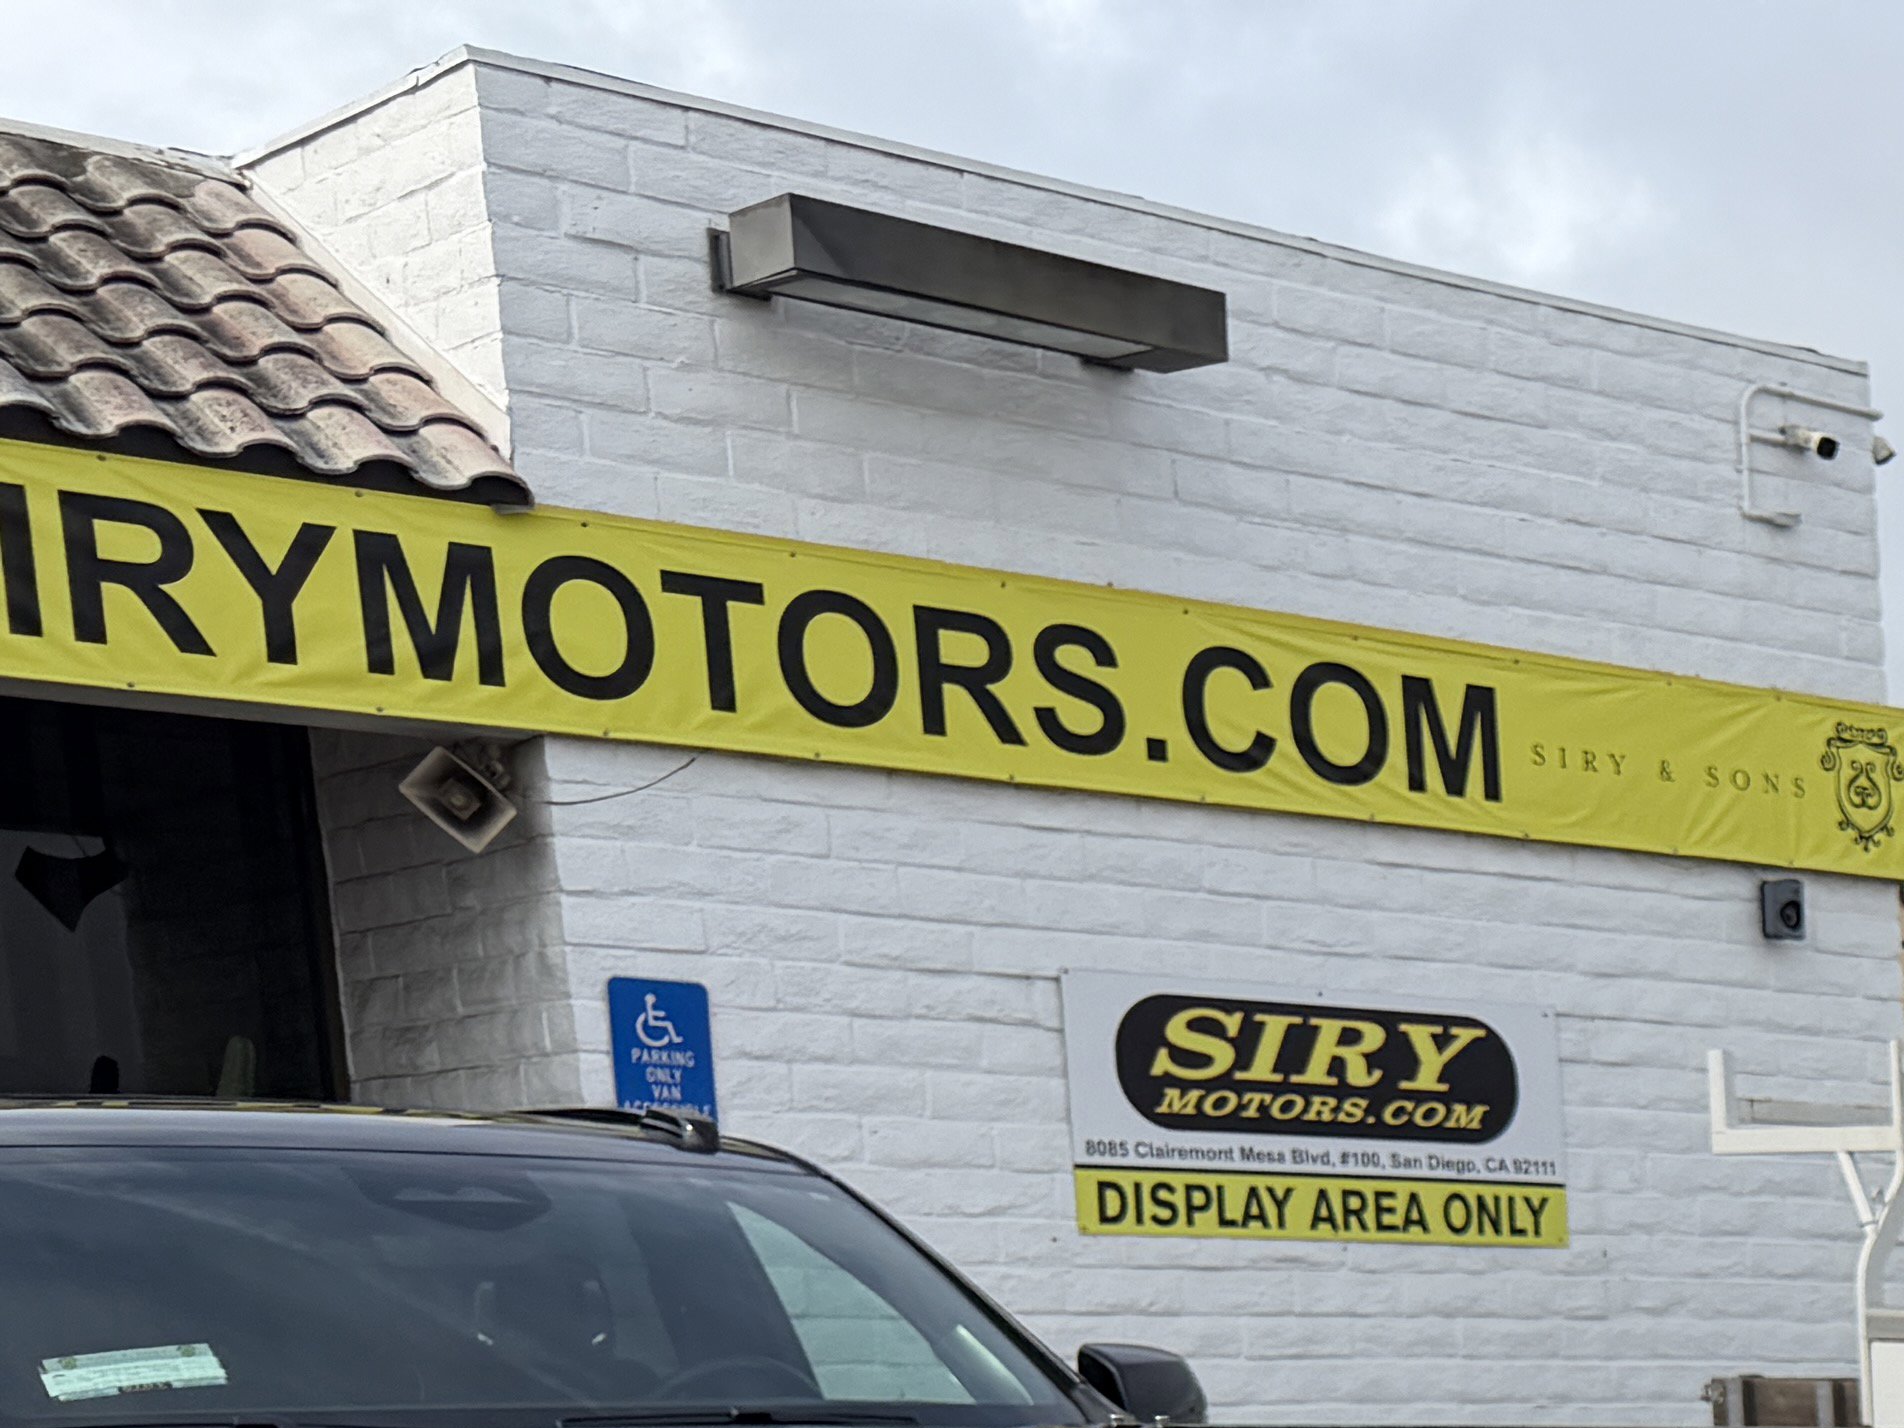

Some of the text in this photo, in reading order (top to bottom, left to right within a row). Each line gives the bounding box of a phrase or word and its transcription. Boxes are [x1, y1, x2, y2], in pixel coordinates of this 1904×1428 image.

[1529, 742, 1807, 799] SIRY & SONS
[631, 1047, 695, 1068] PARKING
[1149, 1007, 1487, 1093] SIRY
[645, 1066, 683, 1084] ONLY
[651, 1084, 682, 1101] VAN
[1154, 1087, 1490, 1131] MOTORS.COM
[1085, 1139, 1130, 1158] 8085
[1134, 1141, 1236, 1162] Clairemont
[1239, 1146, 1287, 1164] Mesa
[1291, 1148, 1336, 1168] Blvd,
[1390, 1152, 1423, 1170] San
[1428, 1154, 1481, 1175] Diego,
[1485, 1157, 1509, 1173] CA
[1513, 1158, 1556, 1176] 92111
[1097, 1180, 1550, 1239] DISPLAY AREA ONLY
